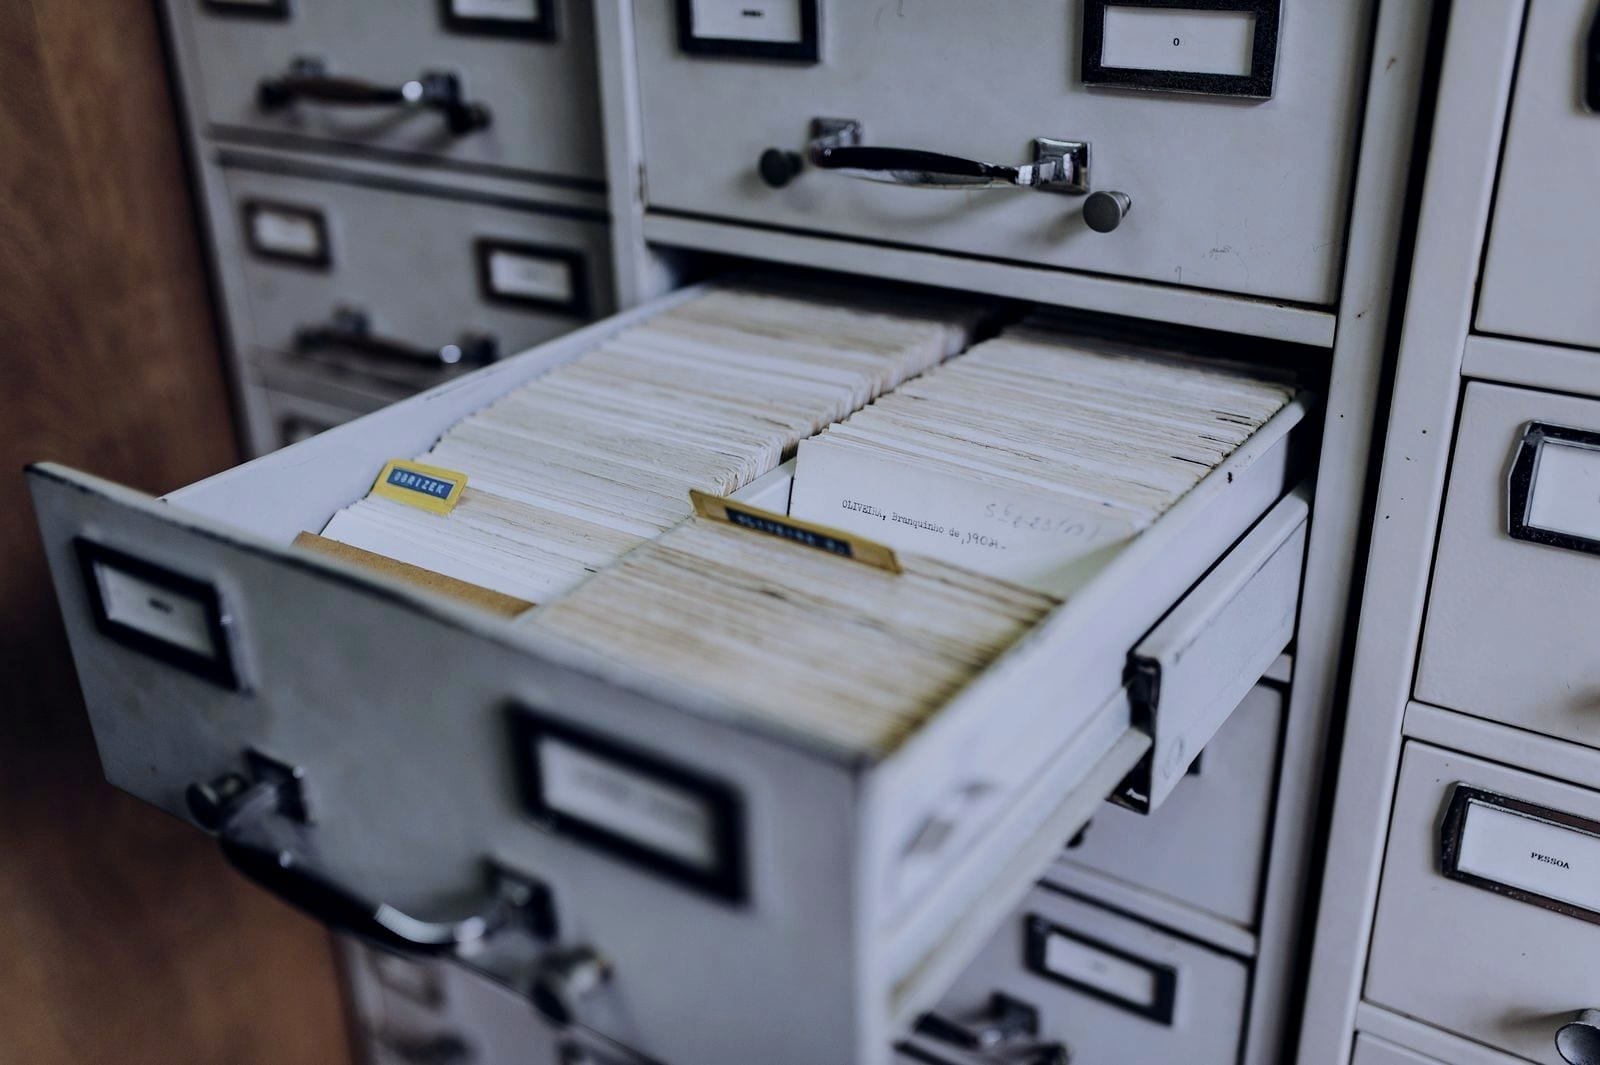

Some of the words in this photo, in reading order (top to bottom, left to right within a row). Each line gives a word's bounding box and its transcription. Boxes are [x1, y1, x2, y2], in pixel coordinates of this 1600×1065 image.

[841, 499, 887, 521] OLIVEIRA,
[891, 512, 945, 534] Branquinho
[948, 526, 960, 538] de
[1530, 851, 1570, 870] PESSOA
